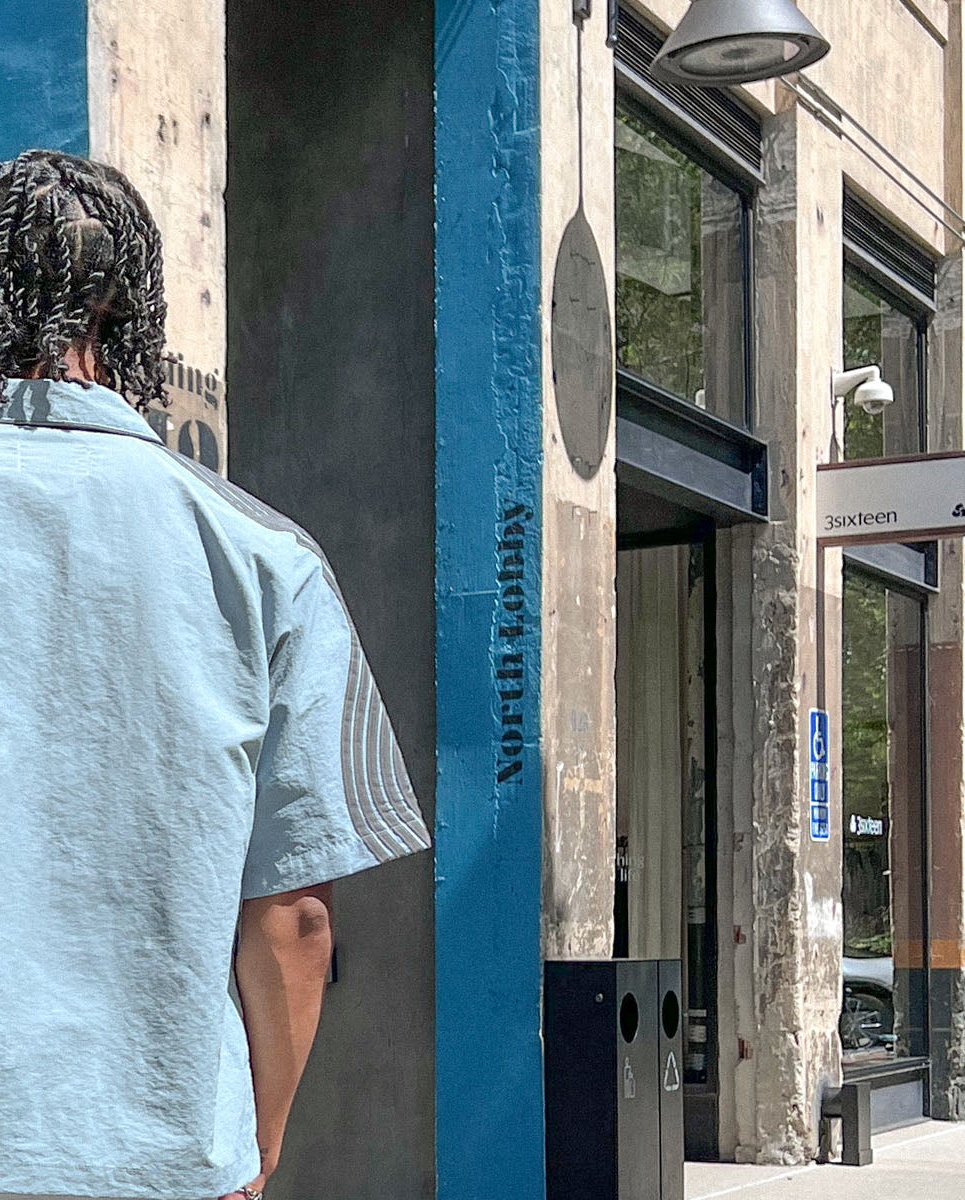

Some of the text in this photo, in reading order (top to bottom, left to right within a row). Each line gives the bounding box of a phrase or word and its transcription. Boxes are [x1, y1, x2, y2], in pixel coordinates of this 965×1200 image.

[824, 510, 897, 531] 3sixteen
[497, 499, 534, 785] North Lobby
